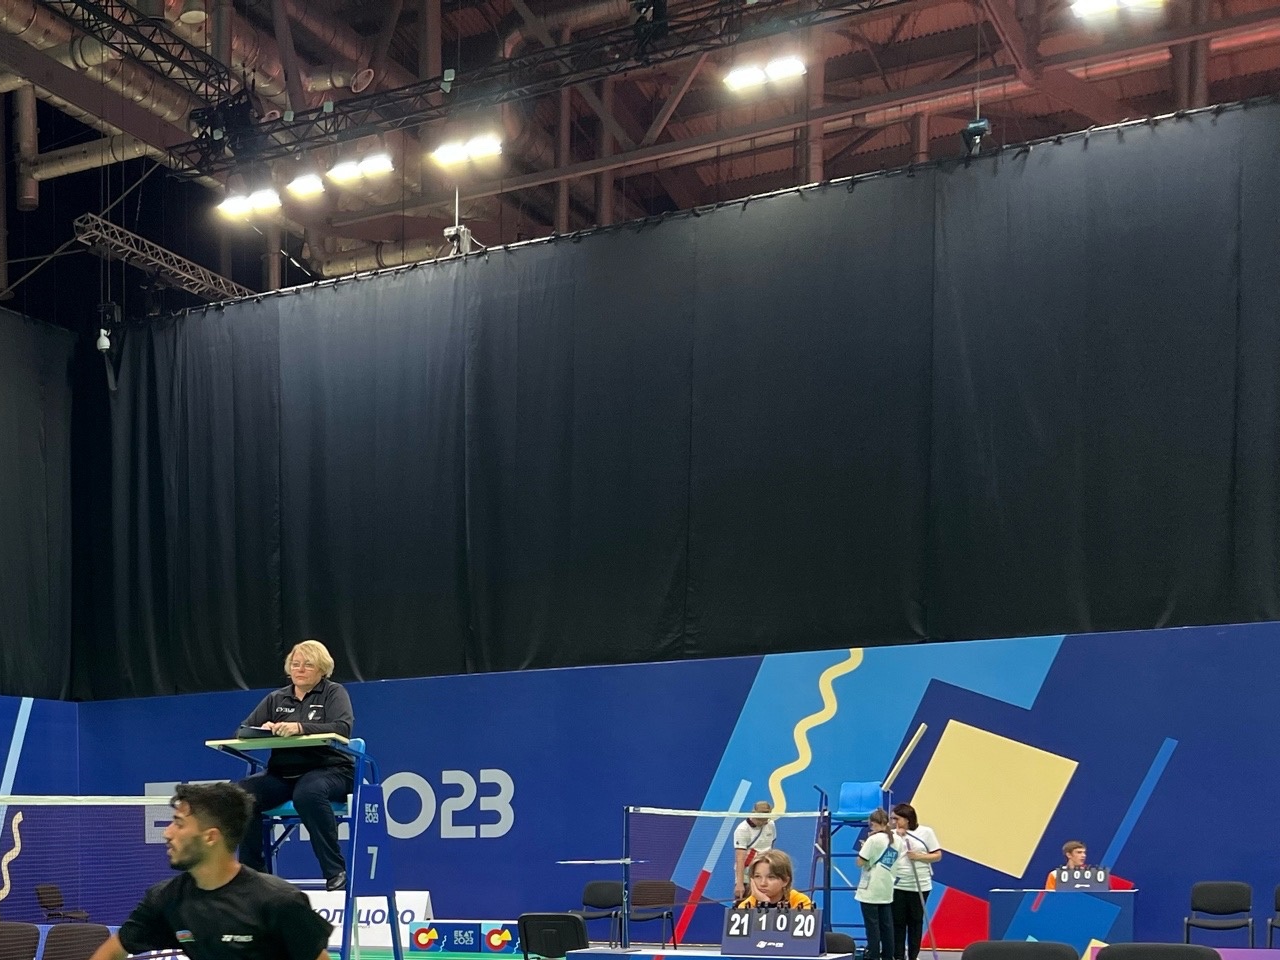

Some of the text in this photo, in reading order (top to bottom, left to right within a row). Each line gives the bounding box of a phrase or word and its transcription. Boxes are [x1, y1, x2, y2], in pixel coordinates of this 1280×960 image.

[338, 769, 515, 840] 023
[364, 803, 379, 812] EKAT
[364, 812, 379, 823] 2023
[367, 846, 379, 879] 7
[1061, 870, 1105, 883] 0 0 0 0
[313, 908, 416, 925] ОЛЦОО
[729, 913, 815, 937] 21 1 0 20
[453, 929, 474, 938] EKAT
